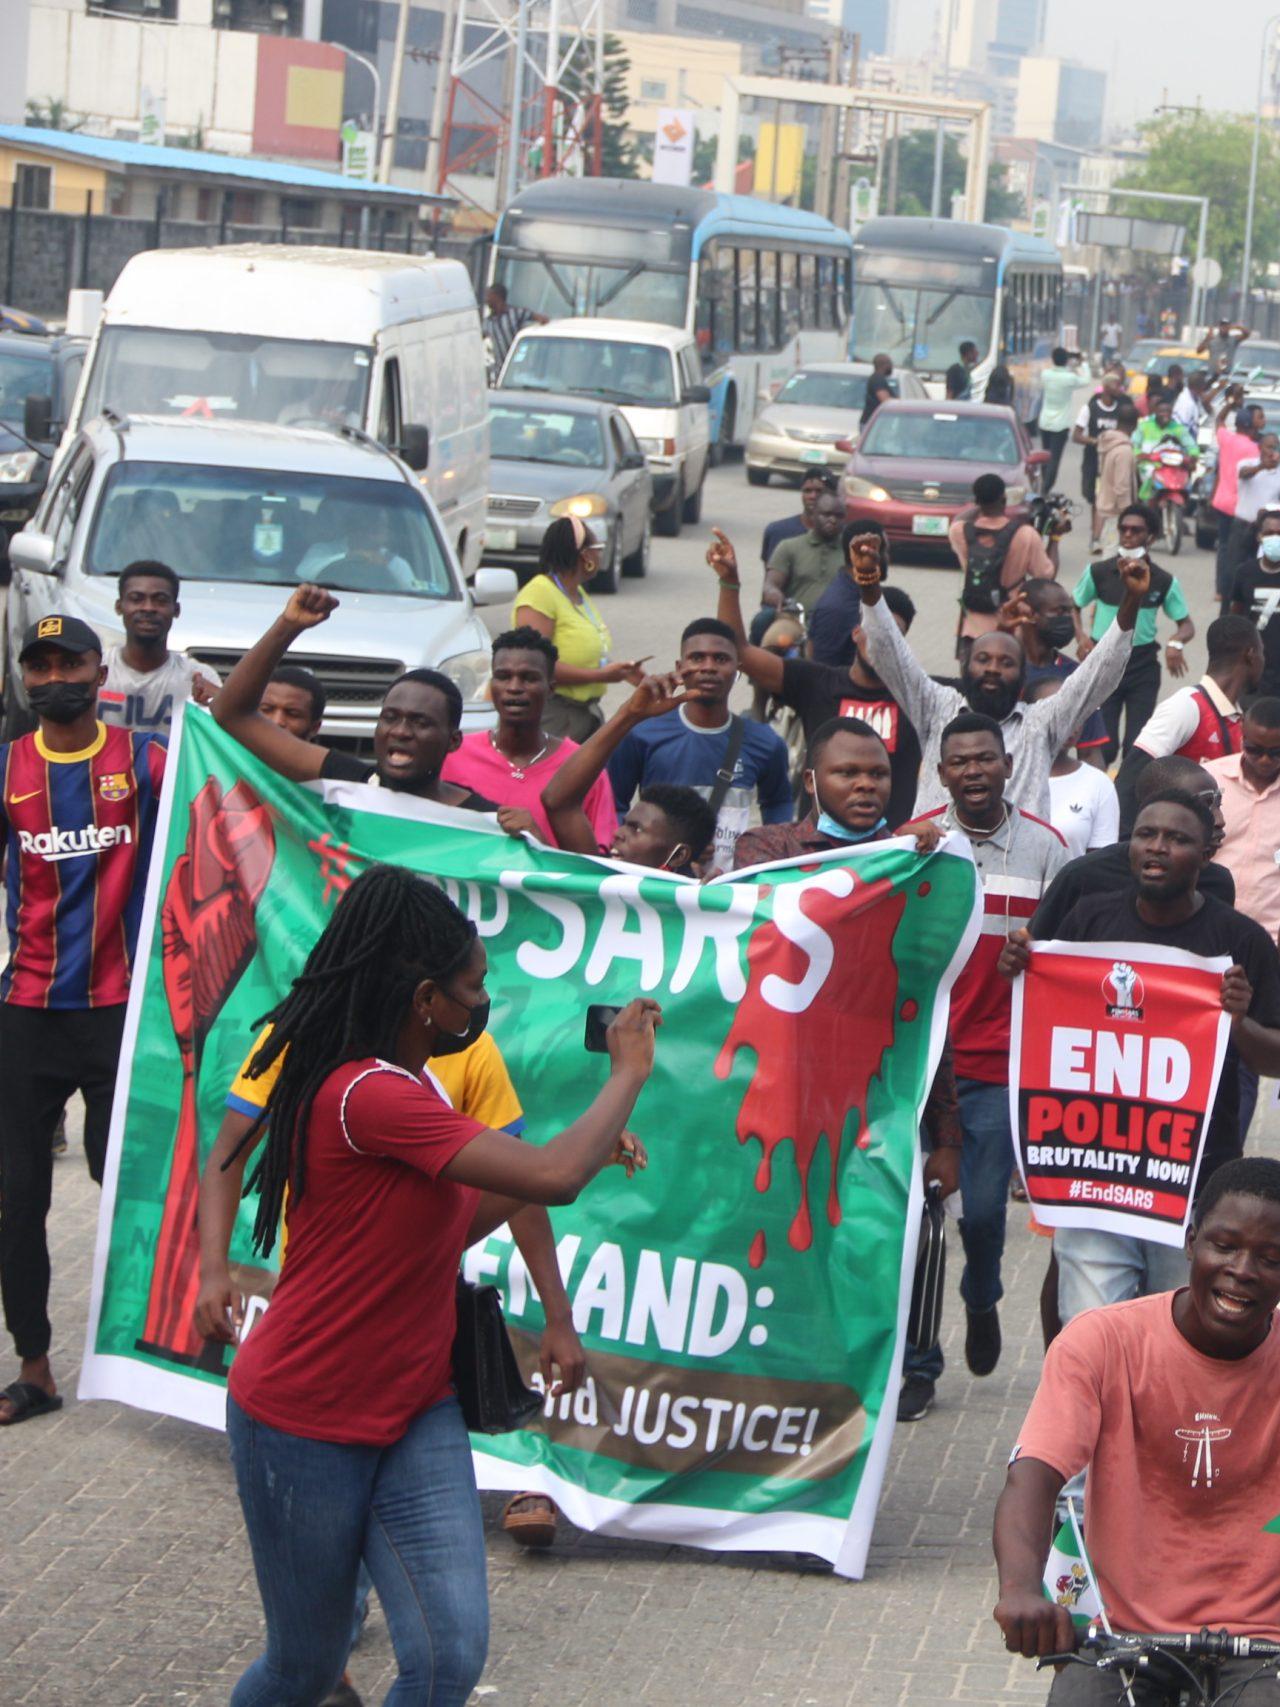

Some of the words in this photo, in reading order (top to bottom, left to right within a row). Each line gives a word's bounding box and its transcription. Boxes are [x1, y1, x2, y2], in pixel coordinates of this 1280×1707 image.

[18, 823, 132, 855] Rakuten
[1050, 1026, 1191, 1103] END
[1027, 1096, 1196, 1161] POLICE
[1027, 1146, 1140, 1175] BRUTALITY
[1146, 1158, 1190, 1185] NOW!
[1069, 1180, 1154, 1209] #EndSARS
[462, 1219, 775, 1358] EMAND:
[613, 1385, 820, 1457] JUSTICE!
